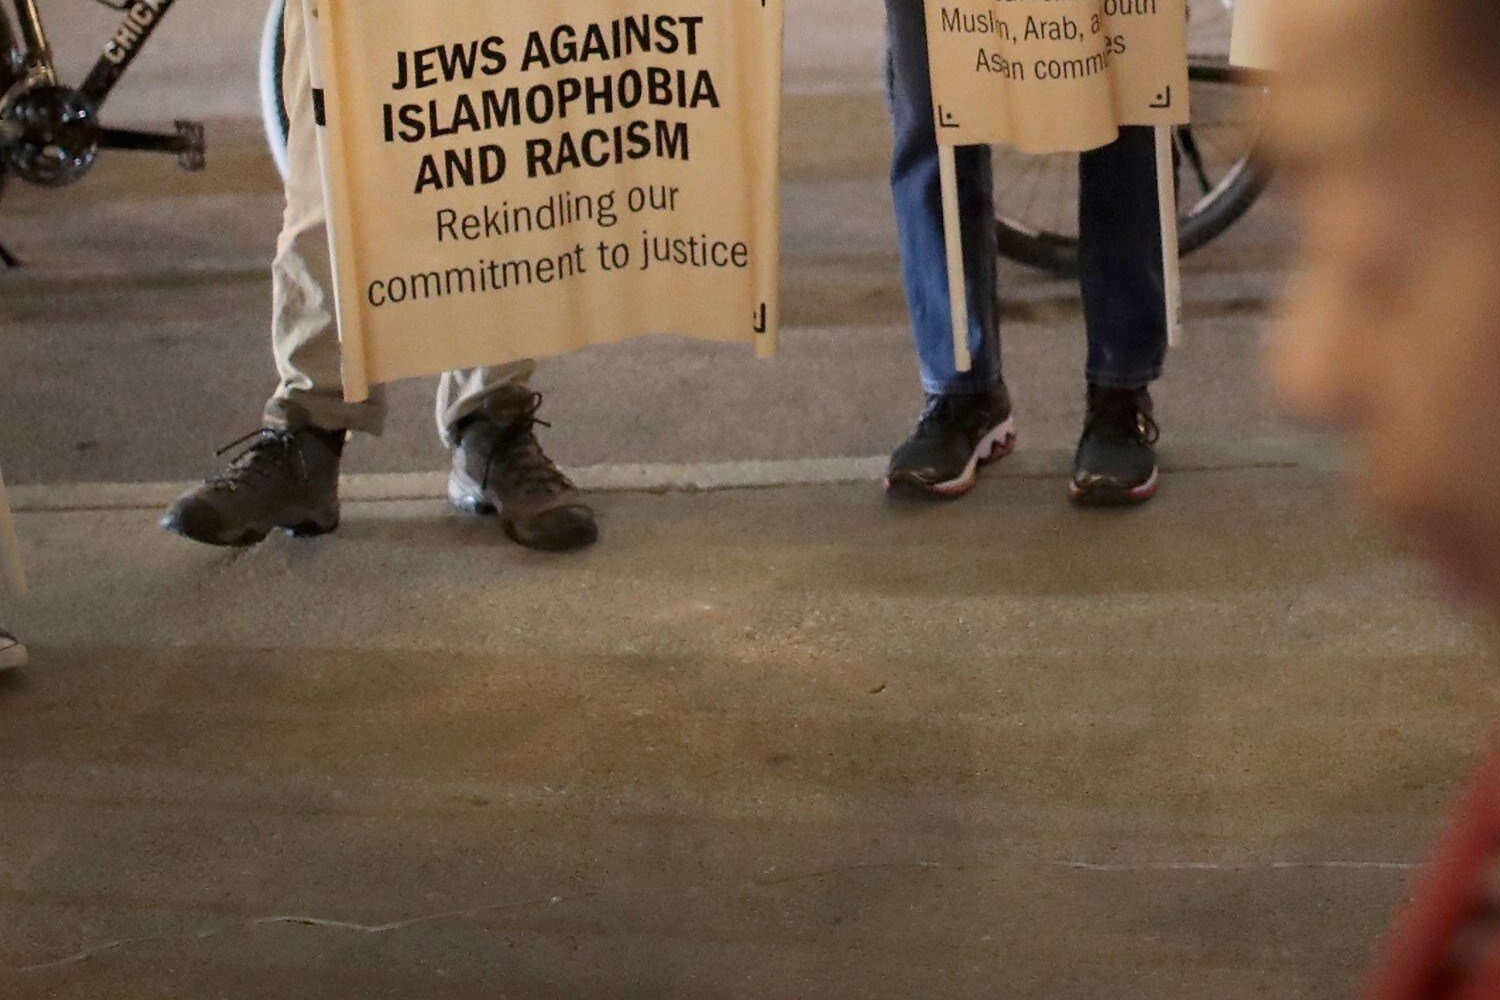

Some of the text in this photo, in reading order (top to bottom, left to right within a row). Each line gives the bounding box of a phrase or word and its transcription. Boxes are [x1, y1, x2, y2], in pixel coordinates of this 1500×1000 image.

[392, 14, 704, 90] JEWS AGAINST
[1024, 15, 1084, 42] Arab,
[383, 67, 720, 142] ISLAMOPHOBIA
[414, 119, 690, 194] AND RACISM
[437, 183, 679, 243] Rekindling our
[368, 230, 749, 307] commitment to justice
